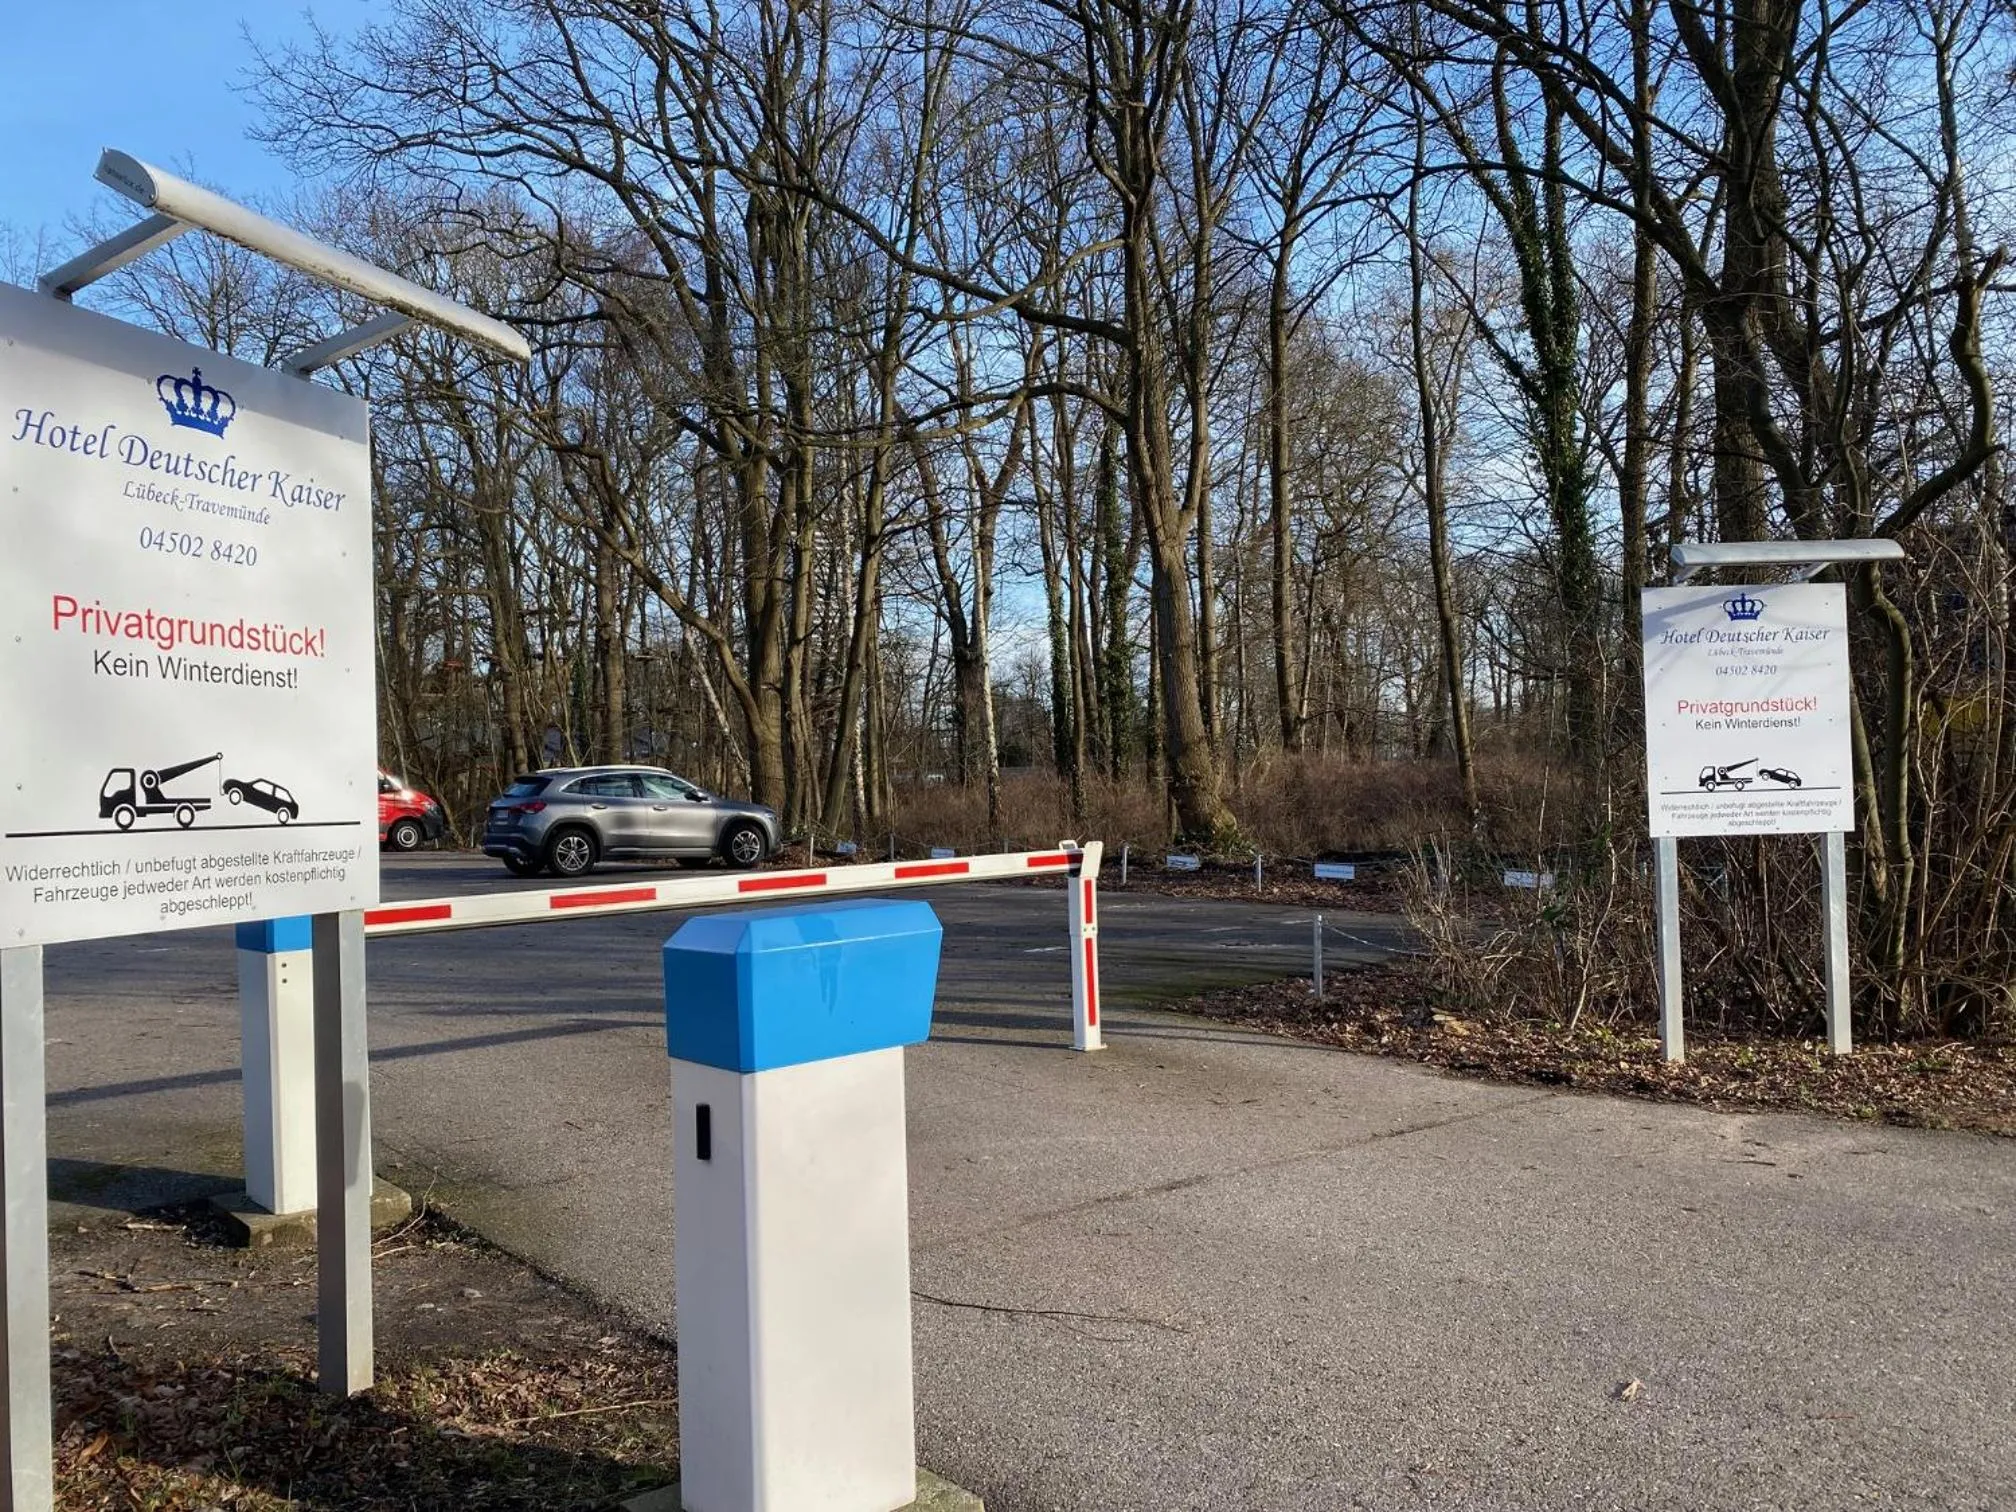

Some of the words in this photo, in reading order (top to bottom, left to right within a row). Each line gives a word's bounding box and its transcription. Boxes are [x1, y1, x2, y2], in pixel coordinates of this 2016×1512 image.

[12, 409, 116, 459] Hotel
[118, 435, 262, 492] Deutscher
[268, 470, 346, 511] Kaiser
[122, 480, 270, 525] Lübeck-Travemünde
[140, 526, 203, 558] 04502
[210, 540, 257, 566] 8420
[52, 595, 325, 657] Privatgrundstück!
[1660, 627, 1704, 645] Hotel
[1705, 626, 1780, 644] Deutscher
[1782, 627, 1831, 643] Kaiser
[94, 650, 148, 678] Kein
[157, 655, 298, 688] Winterdienst!
[1715, 665, 1748, 677] 04502
[1751, 664, 1778, 676] 8420
[1677, 697, 1818, 717] Privatgrundstück!
[1695, 718, 1722, 730] Kein
[1726, 717, 1801, 730] Winterdienst!
[5, 860, 121, 882] Widerrechtlich
[135, 856, 197, 875] unbefugt
[200, 852, 269, 871] abgestellte
[273, 848, 355, 865] Kraftfahrzeuge
[33, 884, 118, 903] Fahrzeuge
[122, 879, 189, 900] jedweder
[192, 876, 211, 891] Art
[215, 873, 262, 888] werden
[265, 867, 346, 884] kostenpflichtig
[160, 892, 252, 915] abgeschleppt!
